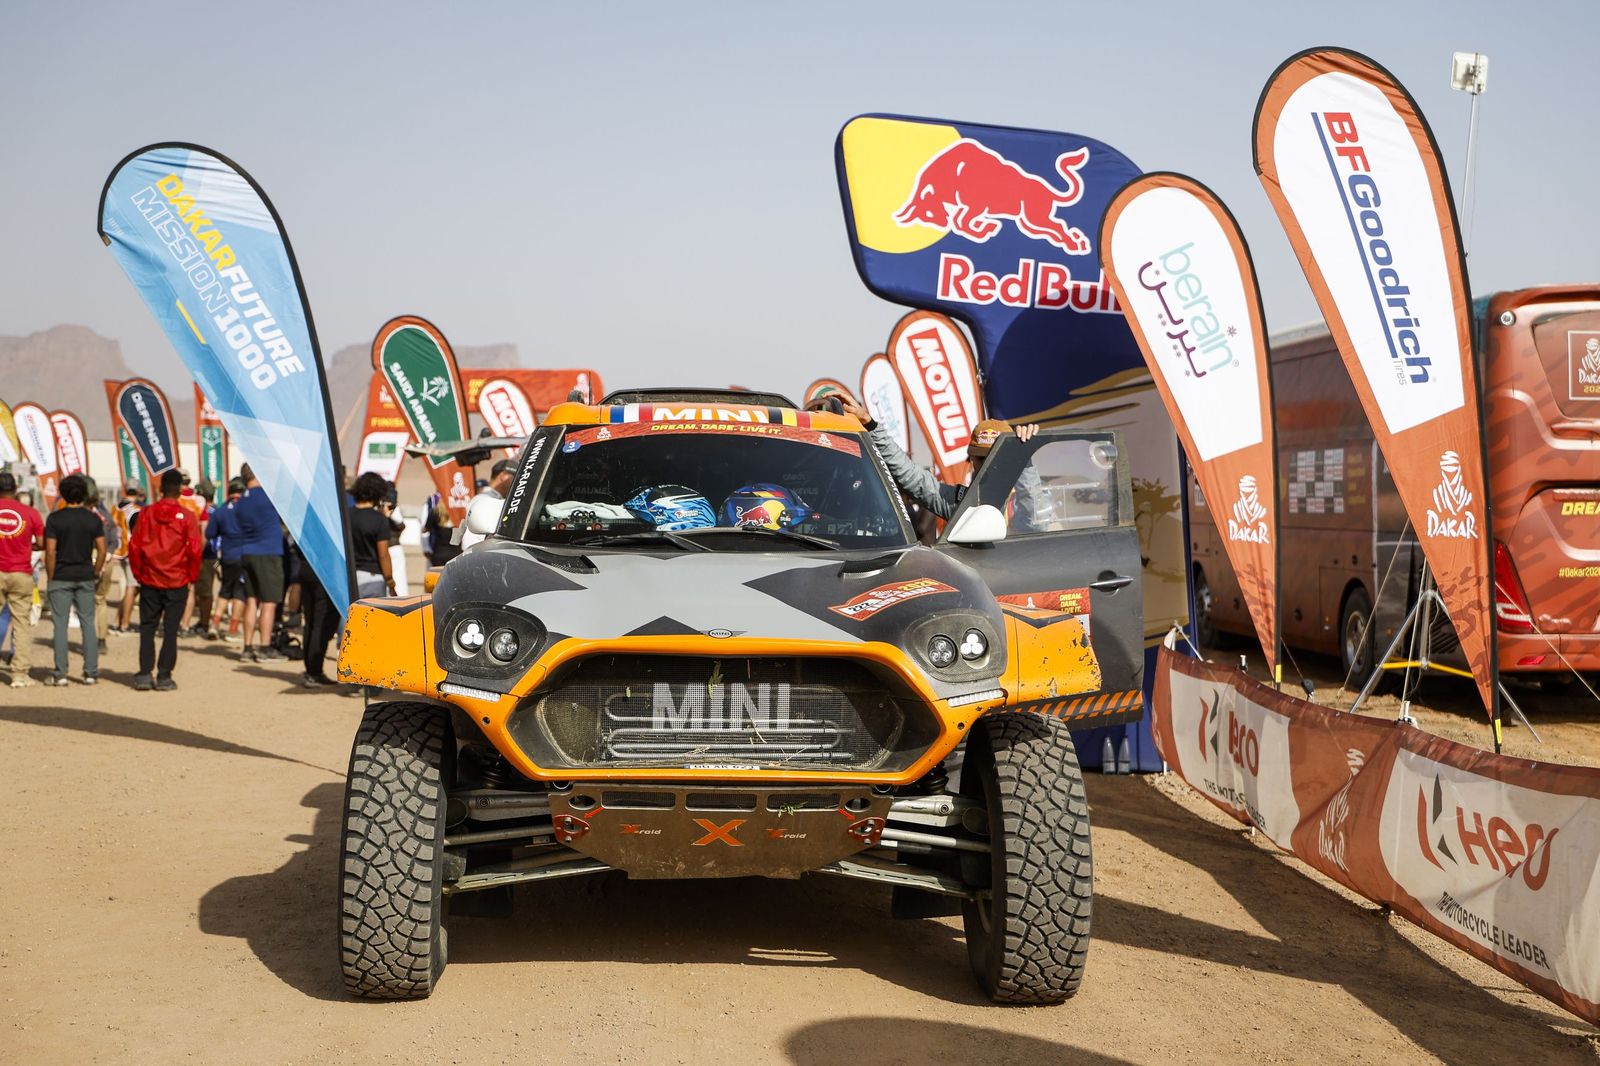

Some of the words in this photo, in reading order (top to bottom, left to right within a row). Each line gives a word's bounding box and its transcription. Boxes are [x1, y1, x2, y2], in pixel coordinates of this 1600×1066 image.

[131, 186, 231, 313] MISSION
[1323, 112, 1432, 384] BFGoodrich
[938, 254, 1034, 306] Red
[1036, 263, 1122, 312] Bul
[1159, 242, 1233, 371] berain
[213, 307, 277, 390] 1000
[1392, 358, 1407, 386] Tires
[390, 361, 415, 399] SAUDI
[409, 398, 436, 442] ARABIA
[652, 407, 770, 423] MINI
[913, 334, 969, 447] MOTUL
[131, 391, 166, 465] DEFENDER
[740, 425, 767, 433] LIVE
[1228, 518, 1270, 545] DAKAR
[1427, 509, 1478, 540] DAKAR
[653, 682, 791, 730] MINI
[691, 818, 747, 846] X
[1443, 899, 1500, 946] MOTORCYCLE
[1501, 929, 1550, 970] LEADER
